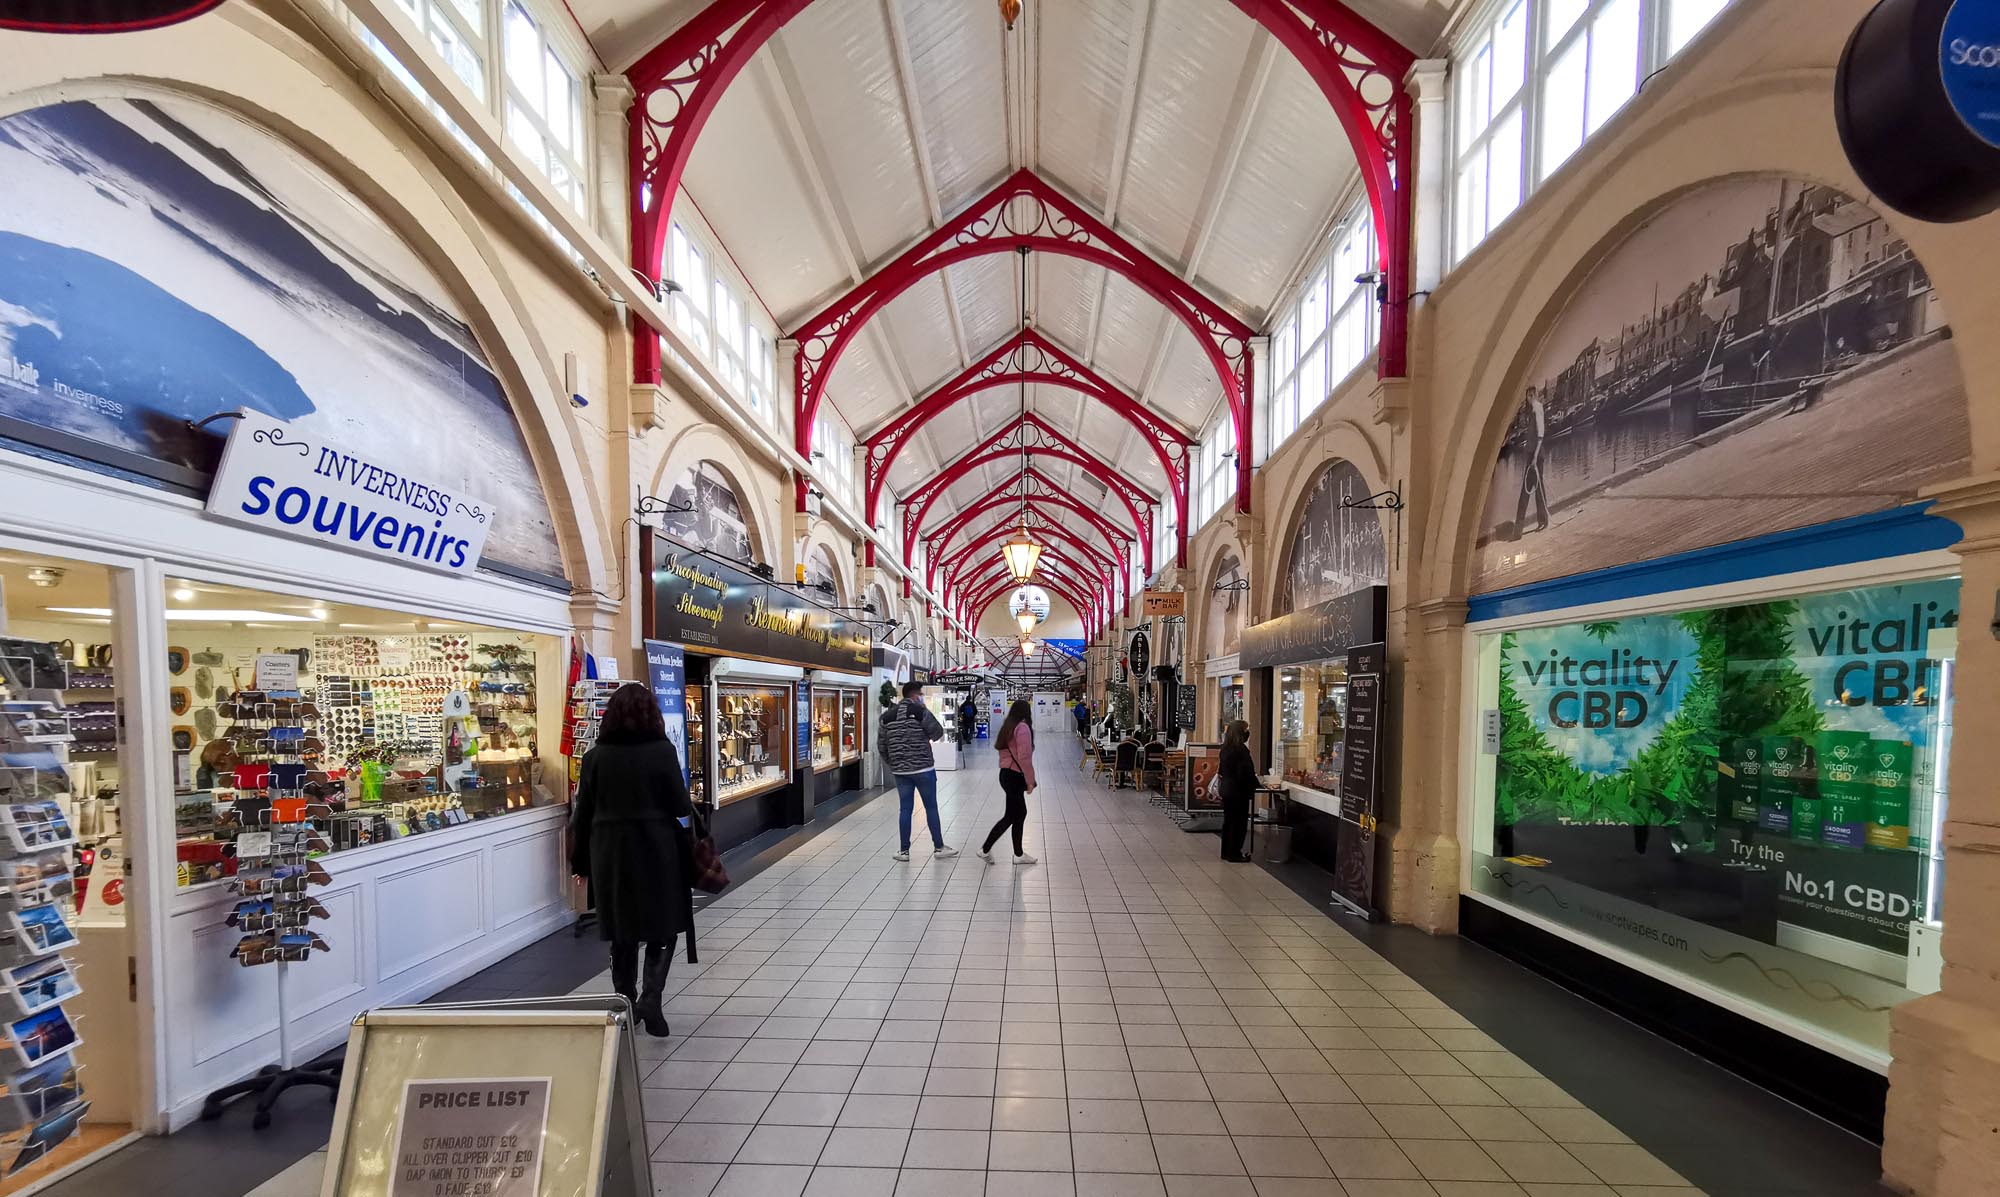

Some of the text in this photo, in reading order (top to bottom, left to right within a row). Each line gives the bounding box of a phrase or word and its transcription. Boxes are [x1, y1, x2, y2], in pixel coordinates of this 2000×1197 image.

[54, 378, 123, 414] inverness
[314, 447, 451, 517] INVERNESS
[241, 476, 469, 568] souvenirs
[667, 553, 728, 599] Incorporating
[676, 592, 723, 629] Silvercraft
[1522, 649, 1678, 695] vitality
[1834, 658, 1938, 707] CBD
[1548, 691, 1648, 729] CBD
[1768, 760, 1793, 771] vitality
[1772, 769, 1789, 777] CBD
[1824, 761, 1858, 774] vitality
[1829, 771, 1851, 781] CBD
[1731, 840, 1785, 863] Try the
[1785, 871, 1835, 900] No.1
[1824, 905, 1865, 921] questions
[1867, 916, 1895, 928] about
[419, 1090, 530, 1109] PRICE LIST
[423, 1135, 519, 1150] STANDARD CUT £12
[403, 1150, 533, 1166] ALL OVER CLIPPER CUT £10
[456, 1167, 469, 1180] TO
